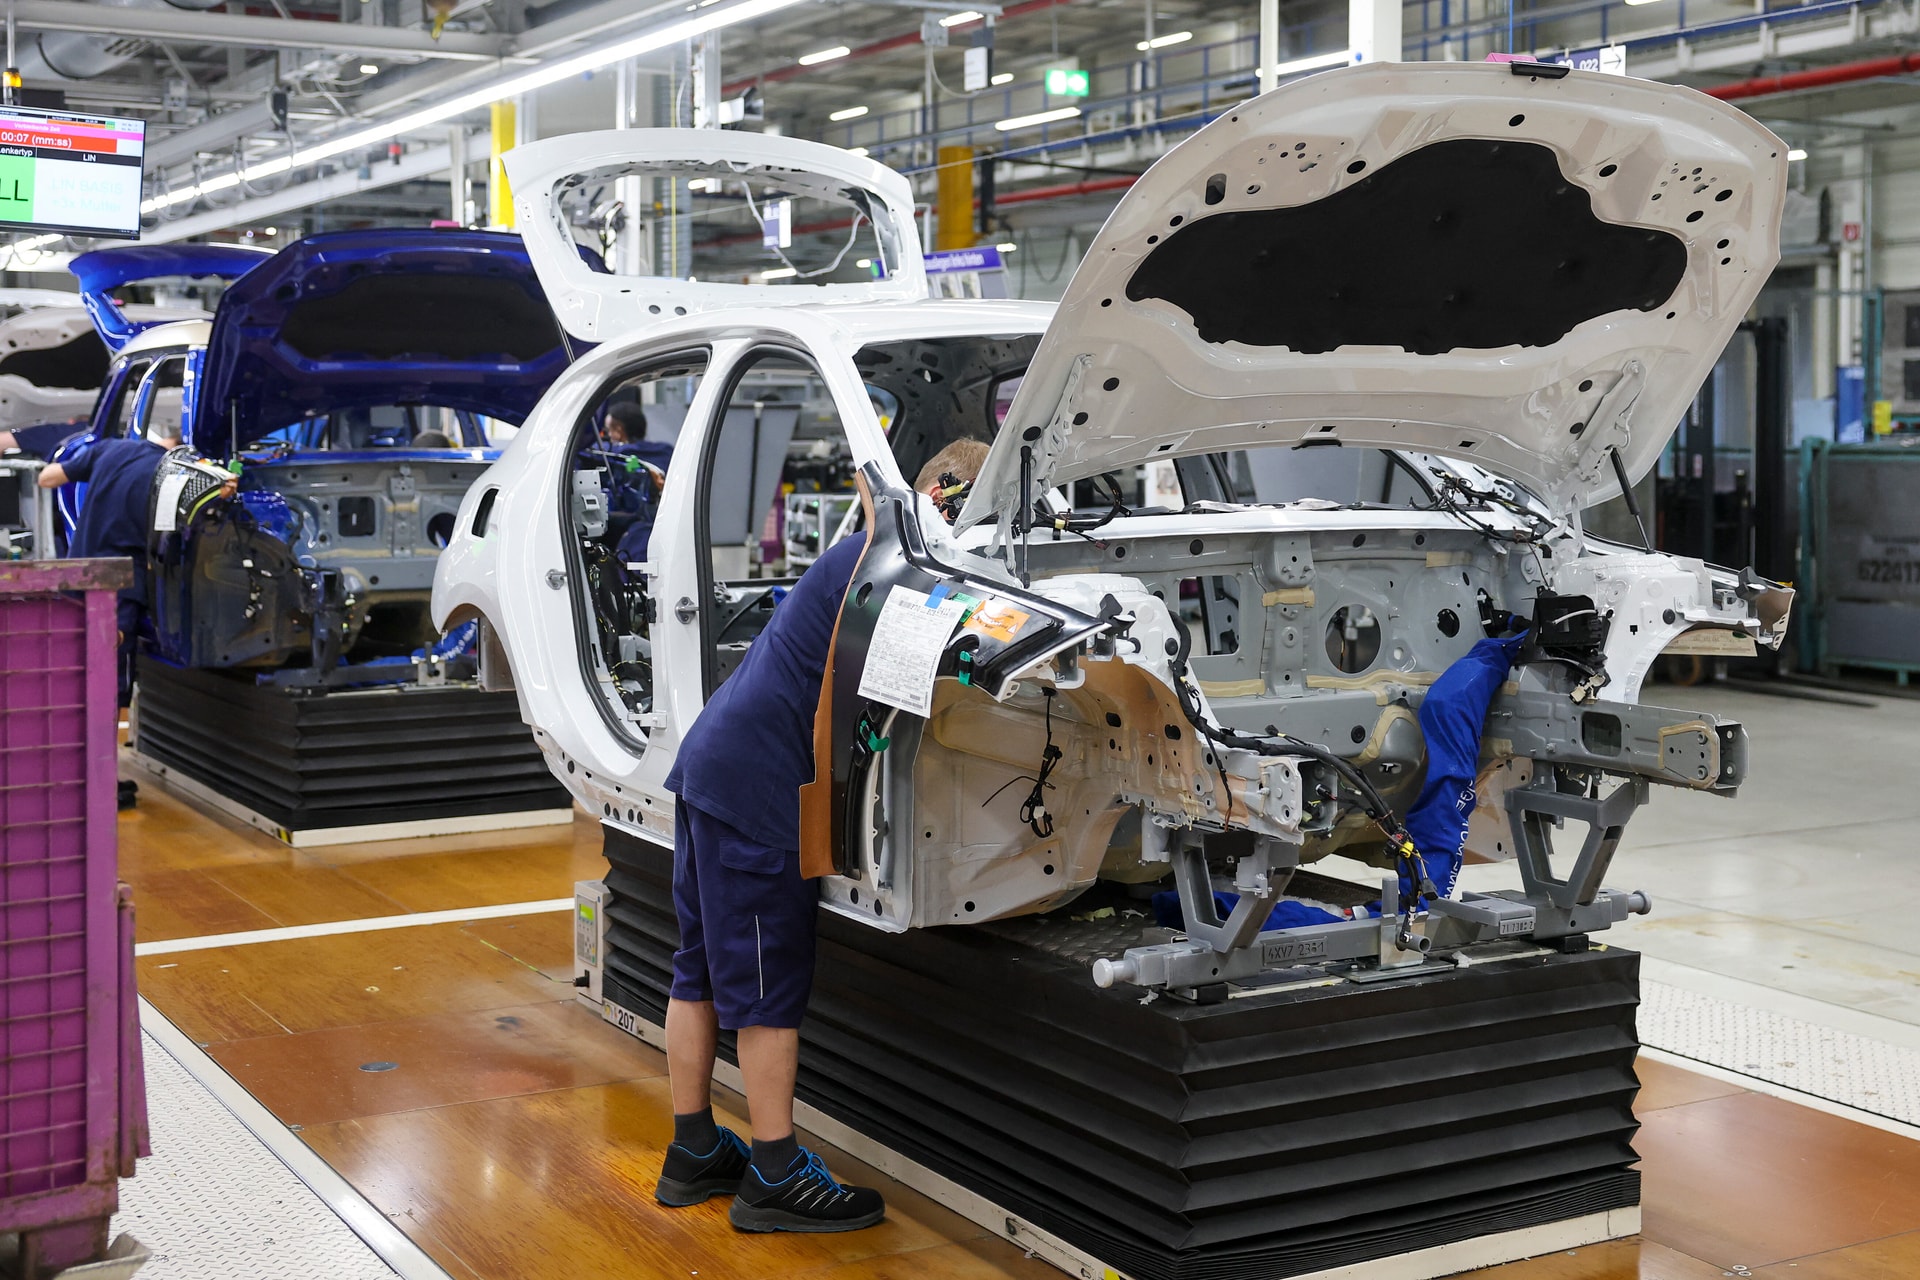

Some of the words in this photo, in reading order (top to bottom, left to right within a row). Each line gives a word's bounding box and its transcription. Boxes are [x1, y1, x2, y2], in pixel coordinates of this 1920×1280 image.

[1, 131, 29, 142] 00:07
[31, 135, 72, 148] (mm:ss)
[0, 147, 33, 158] enkertyp
[83, 153, 96, 162] LIN
[618, 1009, 635, 1031] 207
